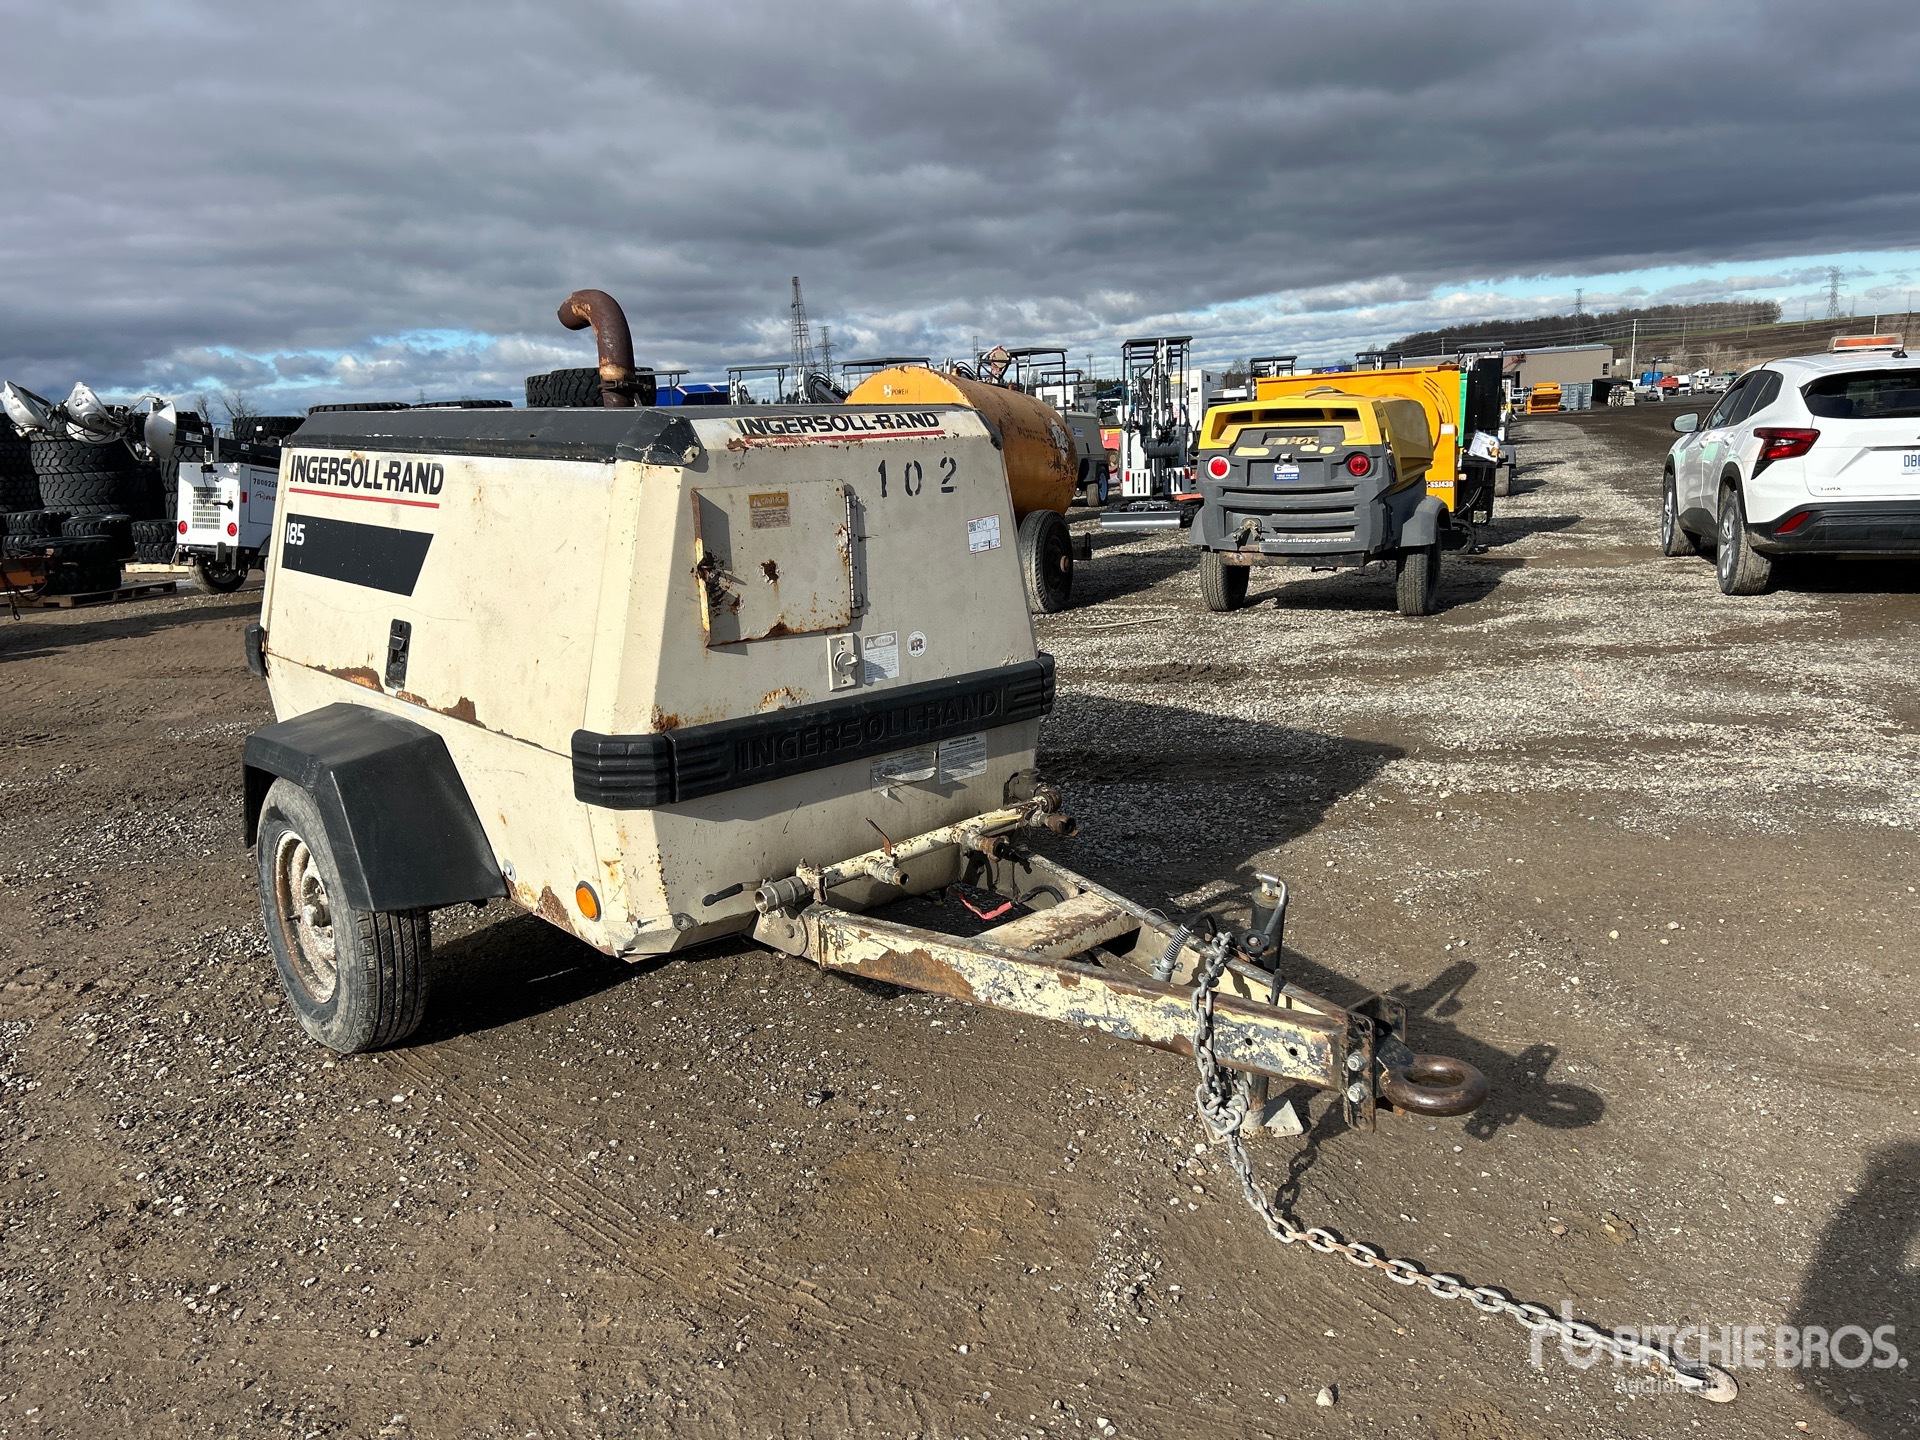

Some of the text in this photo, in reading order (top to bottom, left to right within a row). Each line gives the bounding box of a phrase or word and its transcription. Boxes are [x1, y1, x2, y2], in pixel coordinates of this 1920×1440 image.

[736, 412, 940, 436] INGERSOLL-RAND
[290, 455, 444, 495] INGERSOLL-RAND
[285, 521, 306, 546] 185
[739, 691, 998, 770] INGERSOLL-RAND
